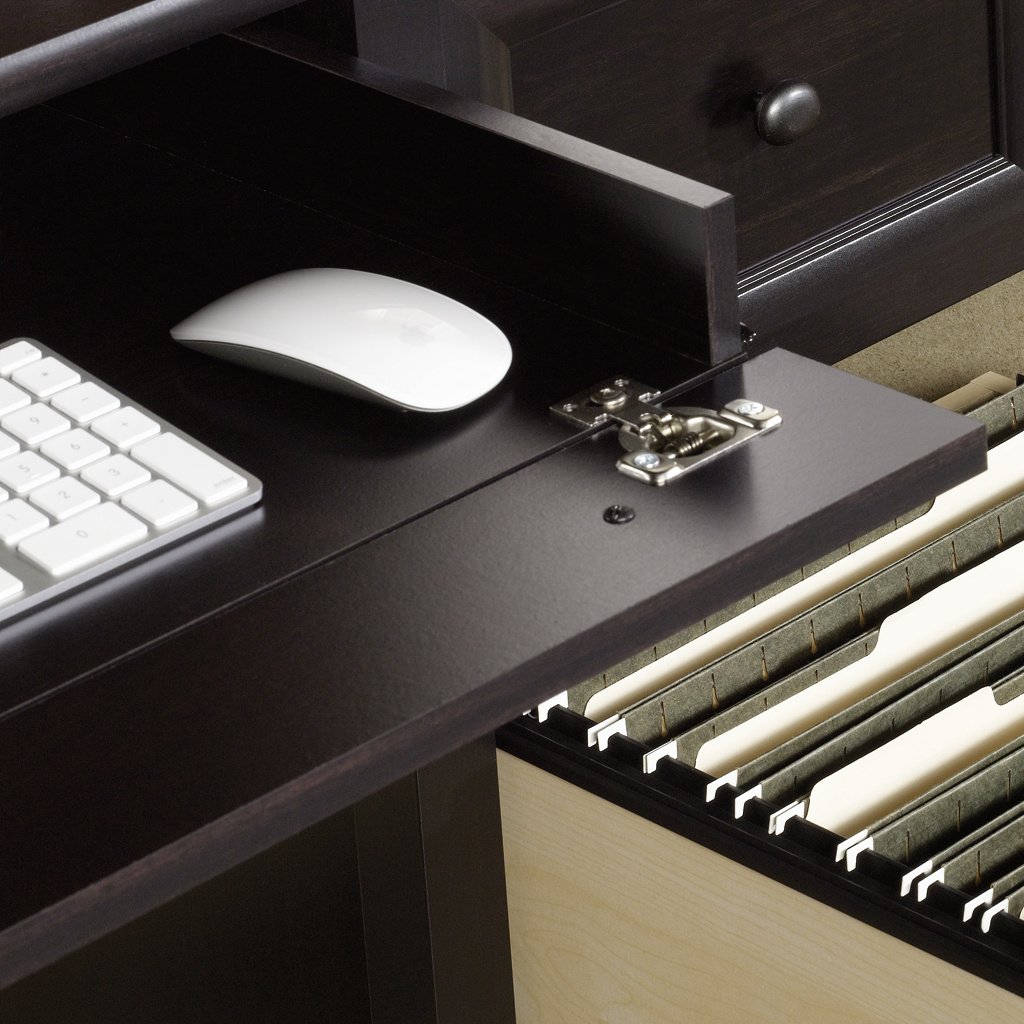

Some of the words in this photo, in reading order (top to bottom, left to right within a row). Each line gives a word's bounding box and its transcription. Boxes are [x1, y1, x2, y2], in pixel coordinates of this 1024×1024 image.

[18, 464, 31, 473] 5
[108, 468, 121, 477] 3
[58, 490, 71, 500] 2
